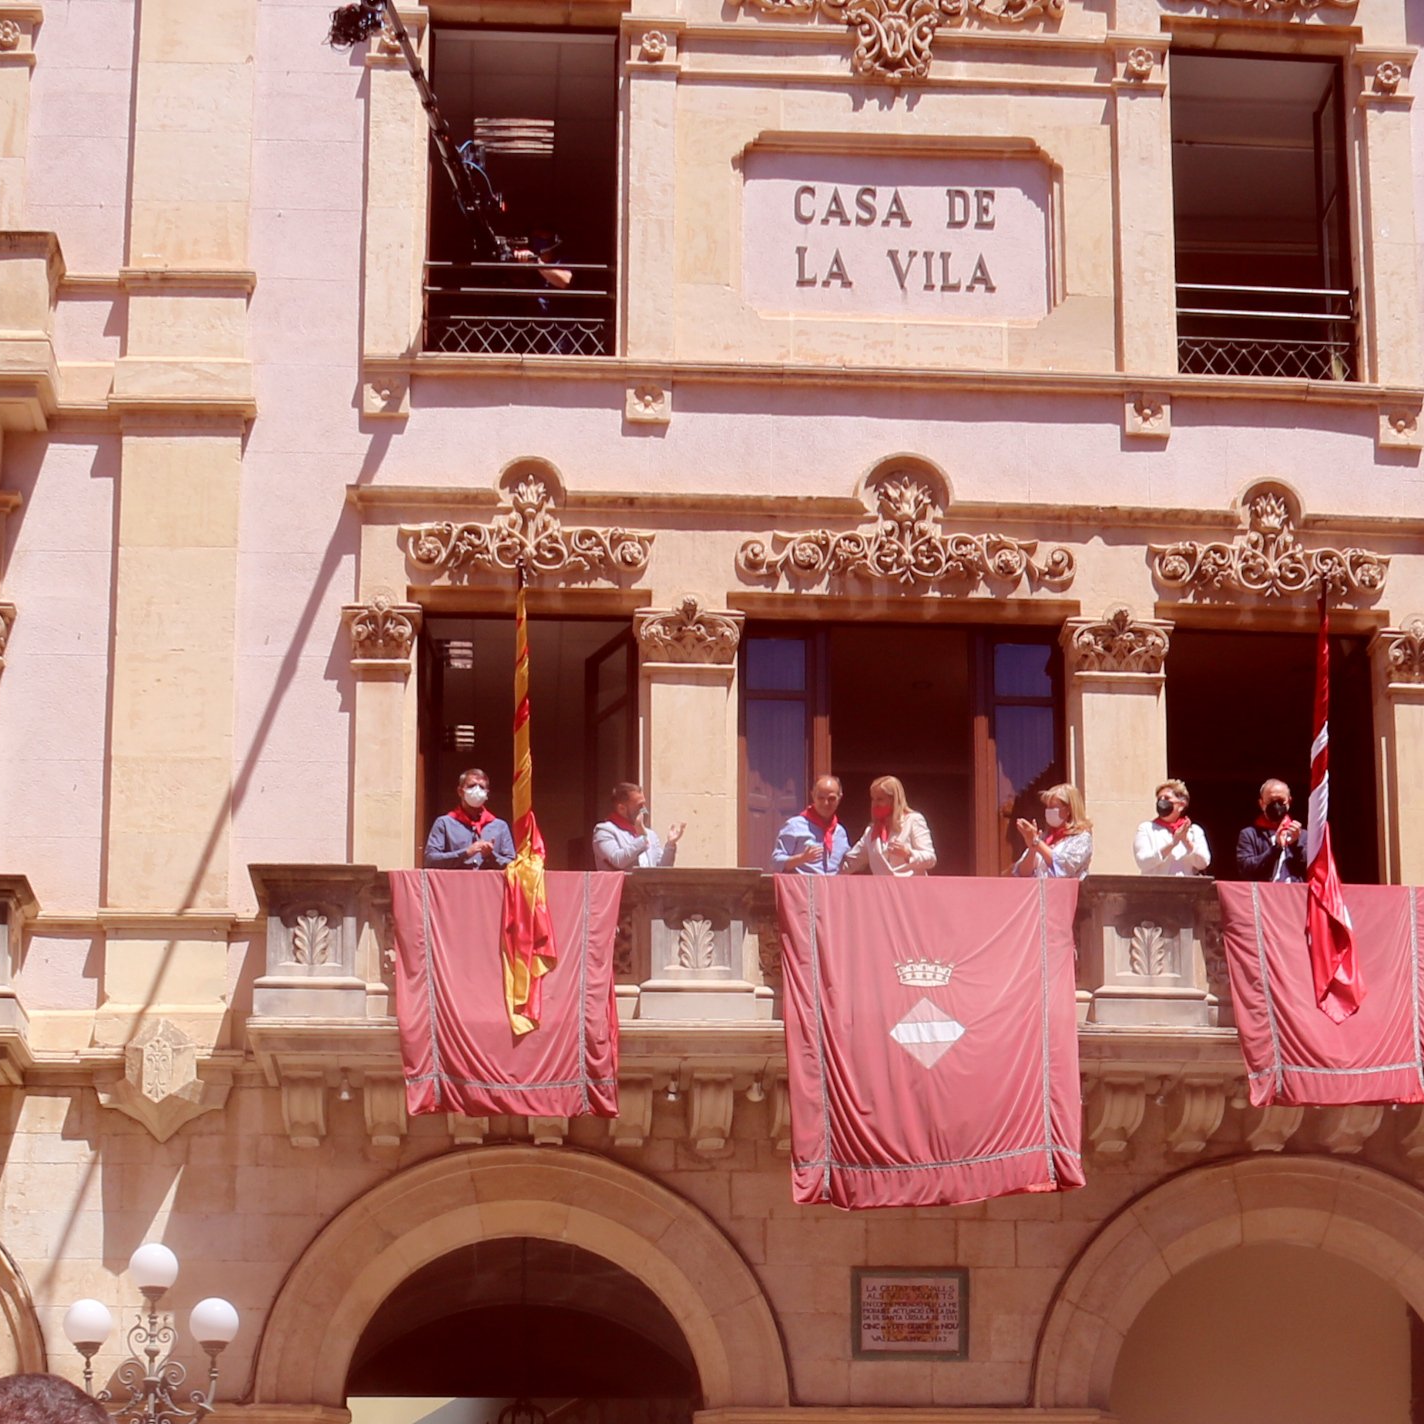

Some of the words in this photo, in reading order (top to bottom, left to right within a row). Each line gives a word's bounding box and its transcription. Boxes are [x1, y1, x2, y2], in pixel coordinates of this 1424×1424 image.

[793, 185, 912, 228] CASA
[946, 188, 996, 230] DE
[794, 246, 853, 289] LA
[887, 249, 997, 293] VILA
